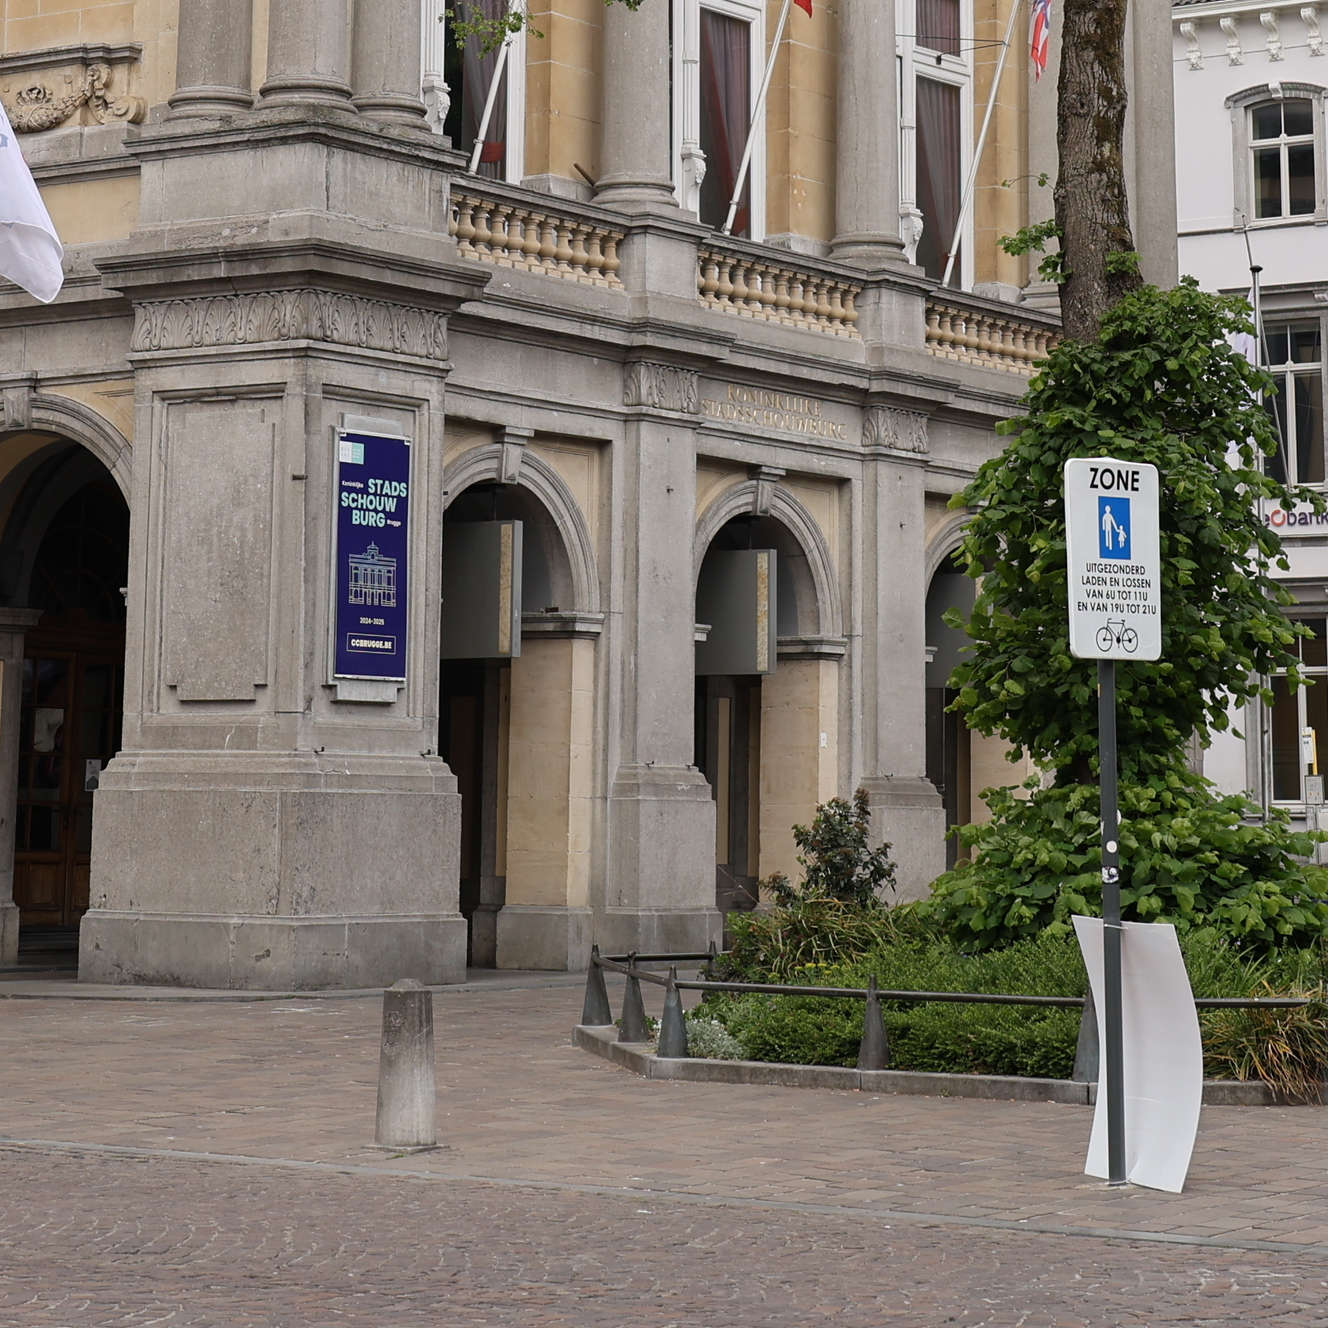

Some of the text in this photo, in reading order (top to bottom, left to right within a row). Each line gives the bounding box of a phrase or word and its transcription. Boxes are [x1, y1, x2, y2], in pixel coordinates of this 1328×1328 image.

[701, 399, 848, 440] STADSSCHOUWBURG
[1089, 467, 1140, 492] ZONE
[368, 478, 407, 498] STADS
[341, 492, 397, 513] SCHOUW
[352, 509, 386, 528] BURG
[1086, 562, 1146, 575] UITGEZONDERD
[1082, 575, 1151, 589] LADEN EN LOSSEN
[1085, 588, 1148, 602] VAN 6U TOT 11U
[1077, 601, 1157, 615] EN VAN 19U TOT 21U
[351, 639, 393, 649] CCBRUGGE.BE
